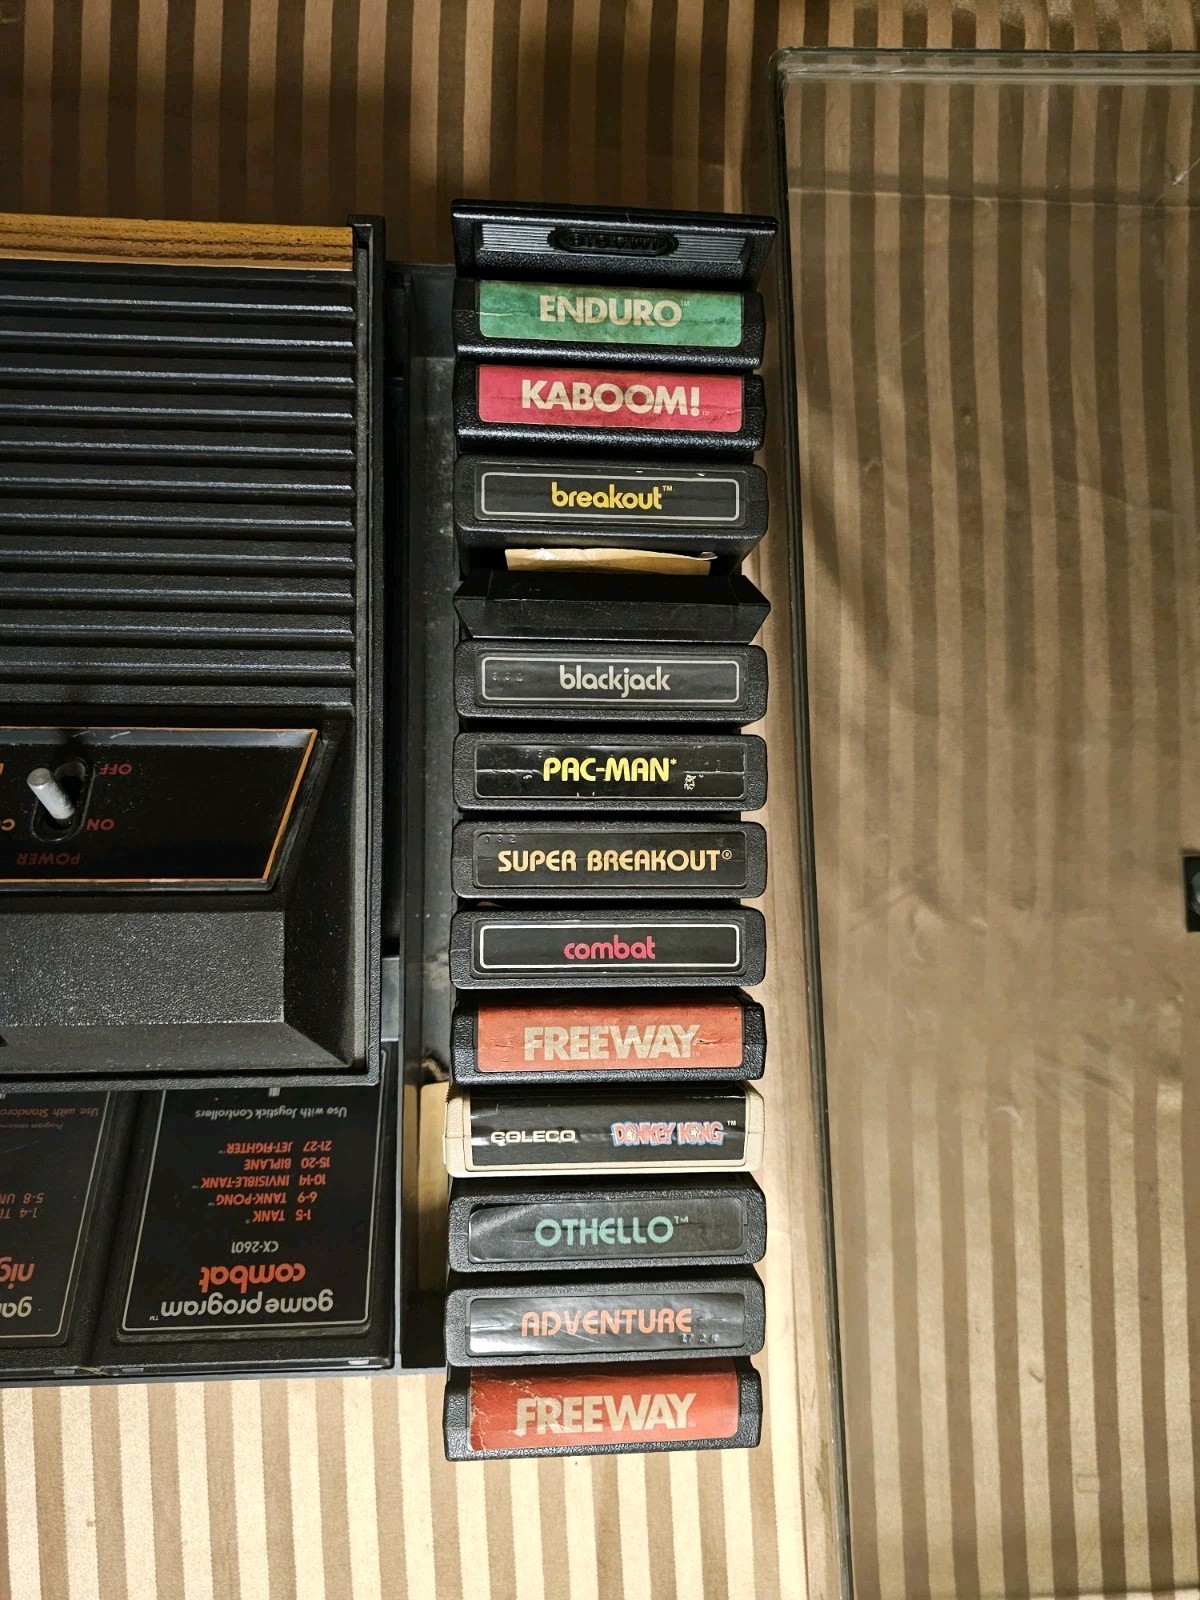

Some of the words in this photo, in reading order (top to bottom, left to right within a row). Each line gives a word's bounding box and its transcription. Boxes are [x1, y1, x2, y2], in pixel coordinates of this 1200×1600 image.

[521, 379, 700, 417] KABOOM!
[559, 664, 671, 698] blackjack
[99, 763, 133, 776] OFF
[86, 818, 115, 831] ON
[16, 852, 81, 866] POWER
[497, 850, 577, 872] SUPER
[563, 934, 656, 960] combat
[523, 1024, 700, 1061] FREEWAY
[53, 1107, 76, 1117] with
[80, 1107, 100, 1117] Use
[195, 1109, 253, 1121] Controllers
[255, 1105, 297, 1120] Joystick
[301, 1107, 323, 1118] with
[327, 1106, 348, 1118] Use
[613, 1122, 676, 1146] DONKEY
[302, 1140, 332, 1151] 21-27
[244, 1157, 292, 1171] BIPLANE
[301, 1156, 331, 1168] 15-20
[299, 1173, 327, 1185] 10-14
[23, 1192, 45, 1204] 5-8
[297, 1191, 318, 1203] 6-9
[19, 1207, 38, 1219] 1-4
[252, 1209, 285, 1222] TANK
[295, 1209, 312, 1221] 1-5
[534, 1216, 674, 1247] OTHELLO
[231, 1240, 279, 1254] CX-2601
[199, 1262, 306, 1294] combat
[160, 1291, 263, 1317] program
[265, 1288, 334, 1312] game
[521, 1308, 692, 1337] ADVENTURE
[514, 1393, 697, 1437] FREEWAY
